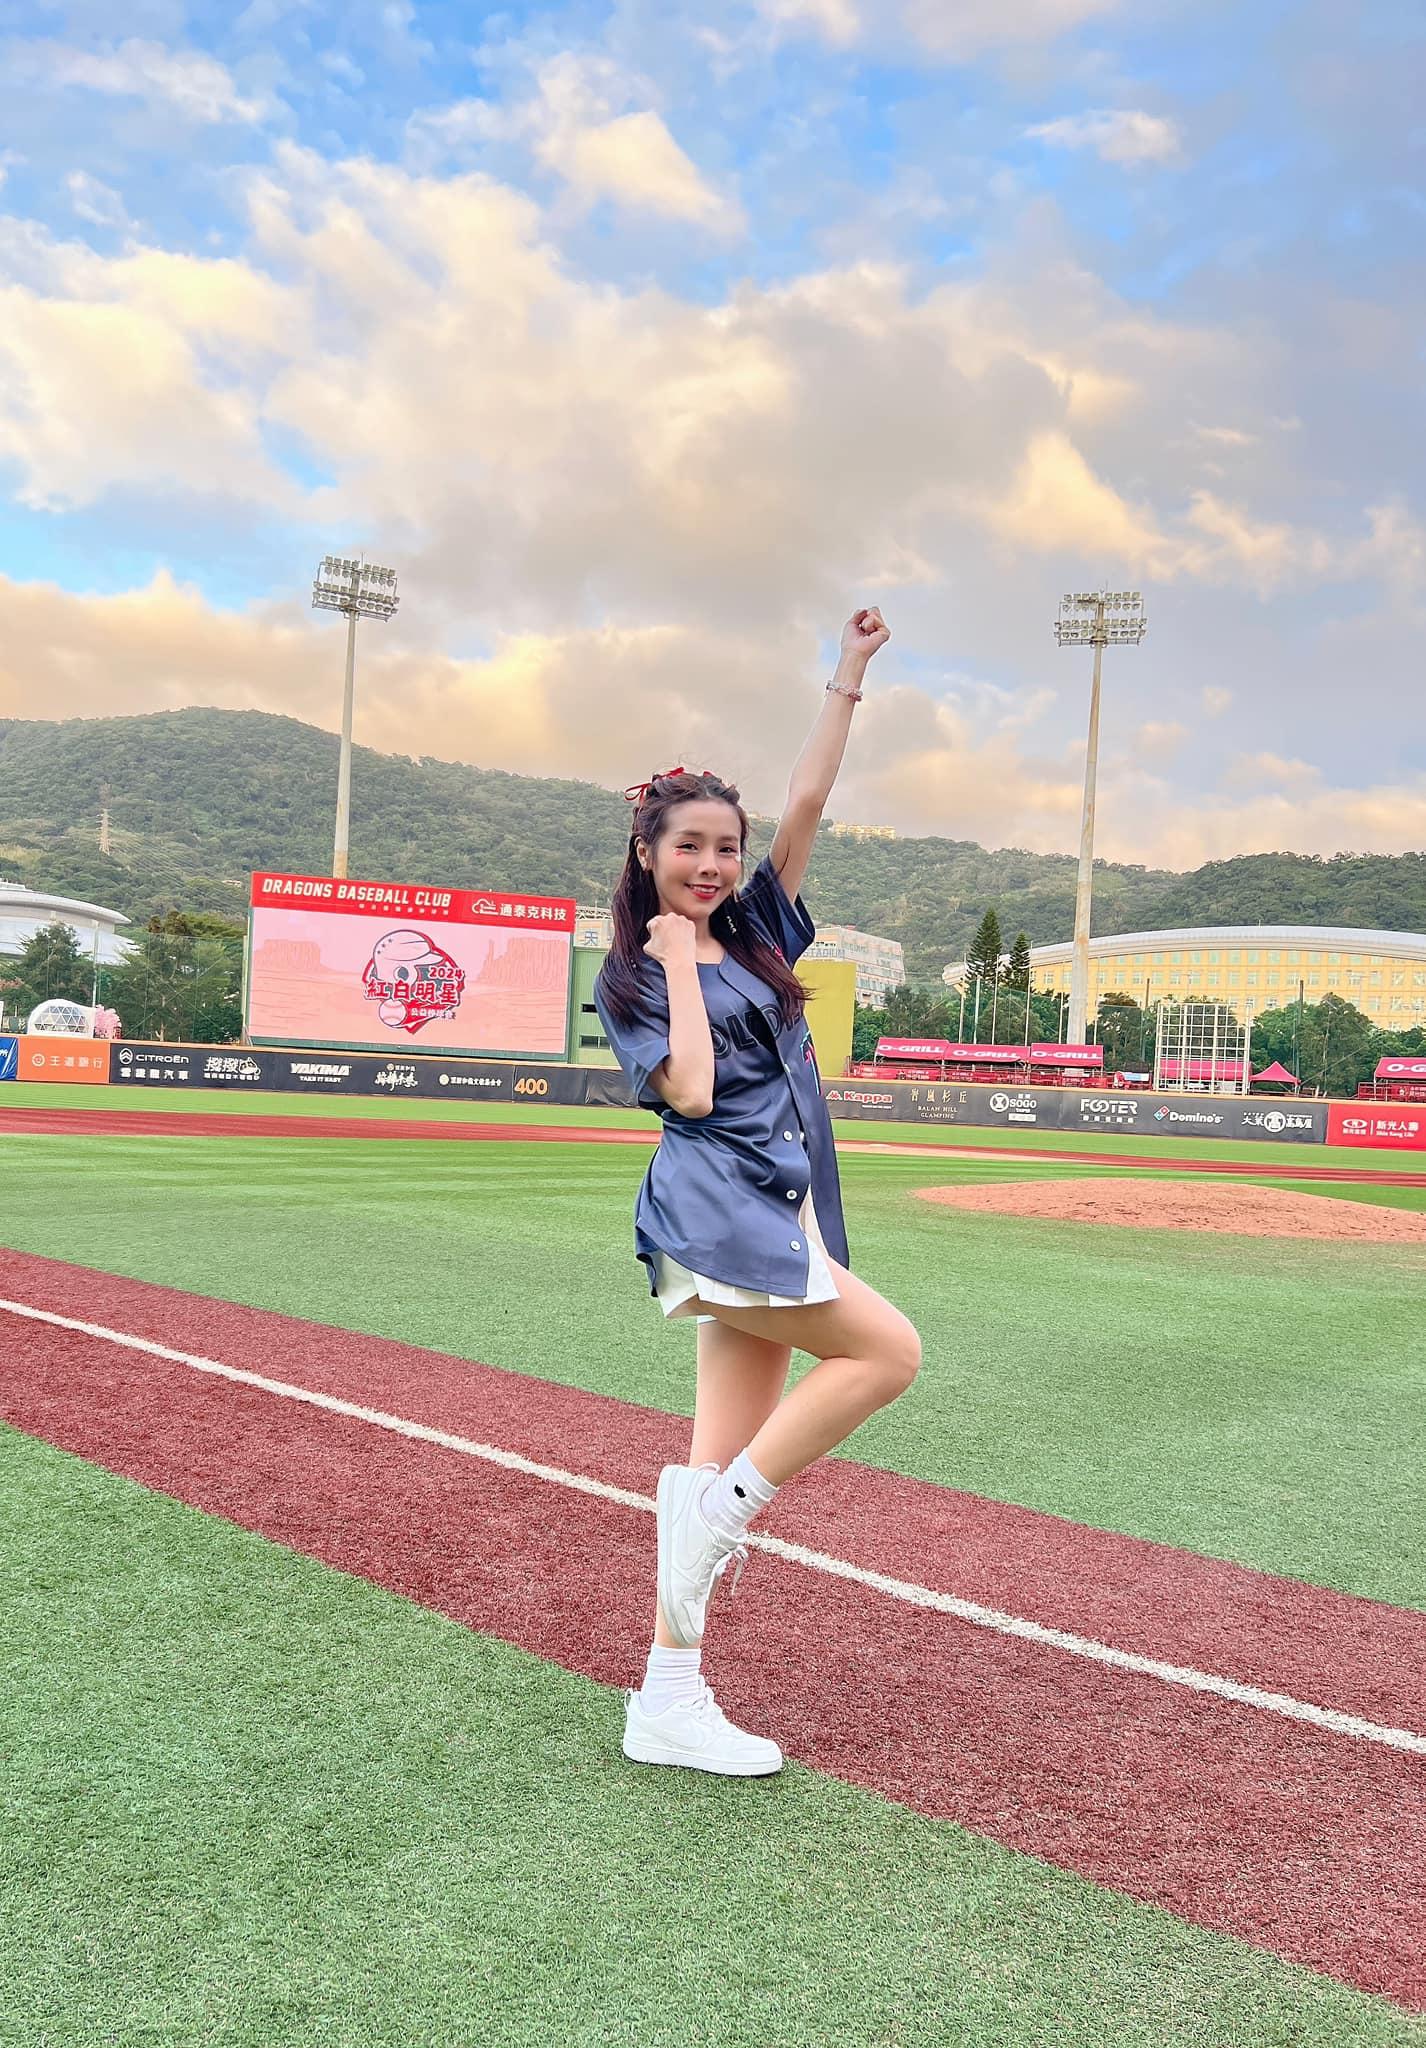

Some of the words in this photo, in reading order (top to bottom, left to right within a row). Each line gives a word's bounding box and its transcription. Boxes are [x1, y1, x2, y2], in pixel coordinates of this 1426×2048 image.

[262, 879, 333, 898] DRAGONS
[337, 885, 409, 905] BASEBALL
[415, 891, 451, 907] CLUB
[500, 903, 567, 921] 通泰克科技
[429, 967, 463, 980] 2024
[366, 979, 458, 1004] 紅白明星
[878, 1043, 944, 1054] O-GRILL
[953, 1048, 1021, 1060] O-GRILL
[1032, 1049, 1103, 1060] O-GRILL
[290, 1063, 351, 1076] YAKIMA
[1386, 1063, 1426, 1073] O-G
[514, 1078, 548, 1096] 400
[843, 1090, 893, 1104] Kappa
[1009, 1098, 1037, 1109] SOGO
[1080, 1099, 1138, 1115] FOOTER
[1169, 1111, 1223, 1124] Domino's
